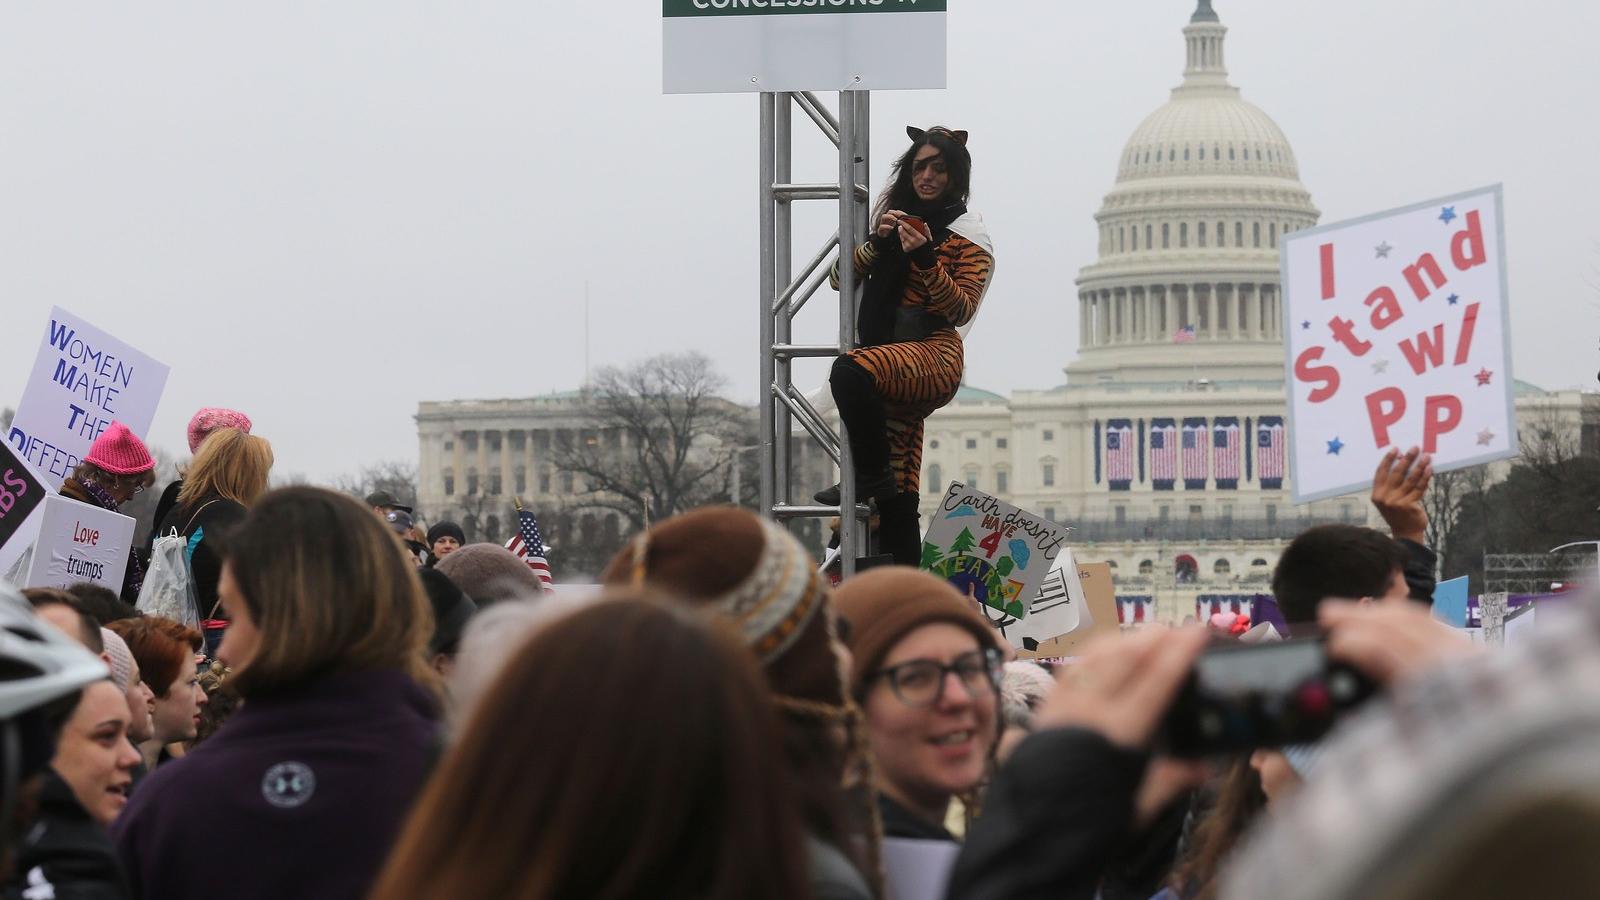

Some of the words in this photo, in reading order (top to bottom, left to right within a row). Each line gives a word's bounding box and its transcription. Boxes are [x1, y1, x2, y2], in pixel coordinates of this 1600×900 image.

[1319, 243, 1336, 300] I
[1294, 210, 1487, 403] Stand
[50, 319, 133, 388] WOMEN
[1398, 302, 1480, 377] w/
[53, 358, 119, 414] MAKE
[1364, 386, 1463, 454] PP
[8, 426, 85, 479] DIFFER
[0, 468, 27, 518] BS
[73, 521, 100, 545] Love
[944, 483, 1001, 516] Earth
[1003, 509, 1065, 561] doesn't
[978, 530, 1004, 559] 4
[981, 514, 1018, 539] HAVE
[67, 554, 104, 583] trumps
[940, 556, 1001, 601] YEARS
